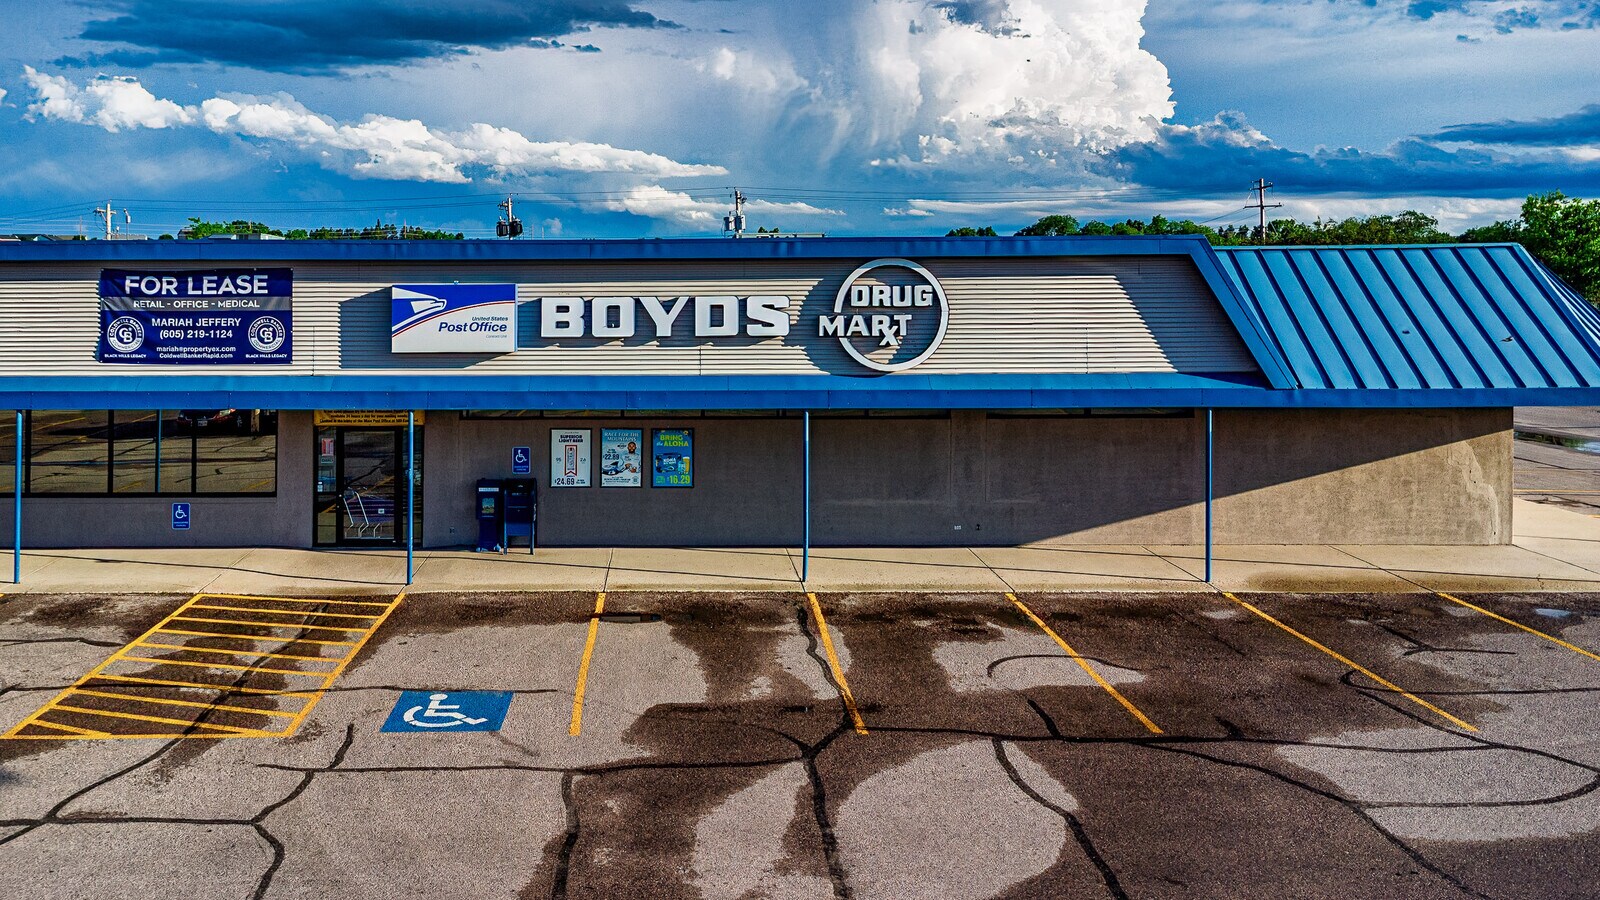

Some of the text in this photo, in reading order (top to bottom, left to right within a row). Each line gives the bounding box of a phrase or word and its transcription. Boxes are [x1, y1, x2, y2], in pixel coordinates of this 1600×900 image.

[125, 275, 268, 294] FOR LEASE
[851, 285, 933, 306] DRUG
[152, 318, 241, 326] MARIAH JEFFERY
[541, 296, 790, 337] BOYDS
[119, 327, 133, 342] CB
[160, 330, 233, 339] (605) 219-1124
[250, 319, 270, 336] COLDWELL
[260, 327, 273, 342] CB
[438, 322, 507, 332] Post Office
